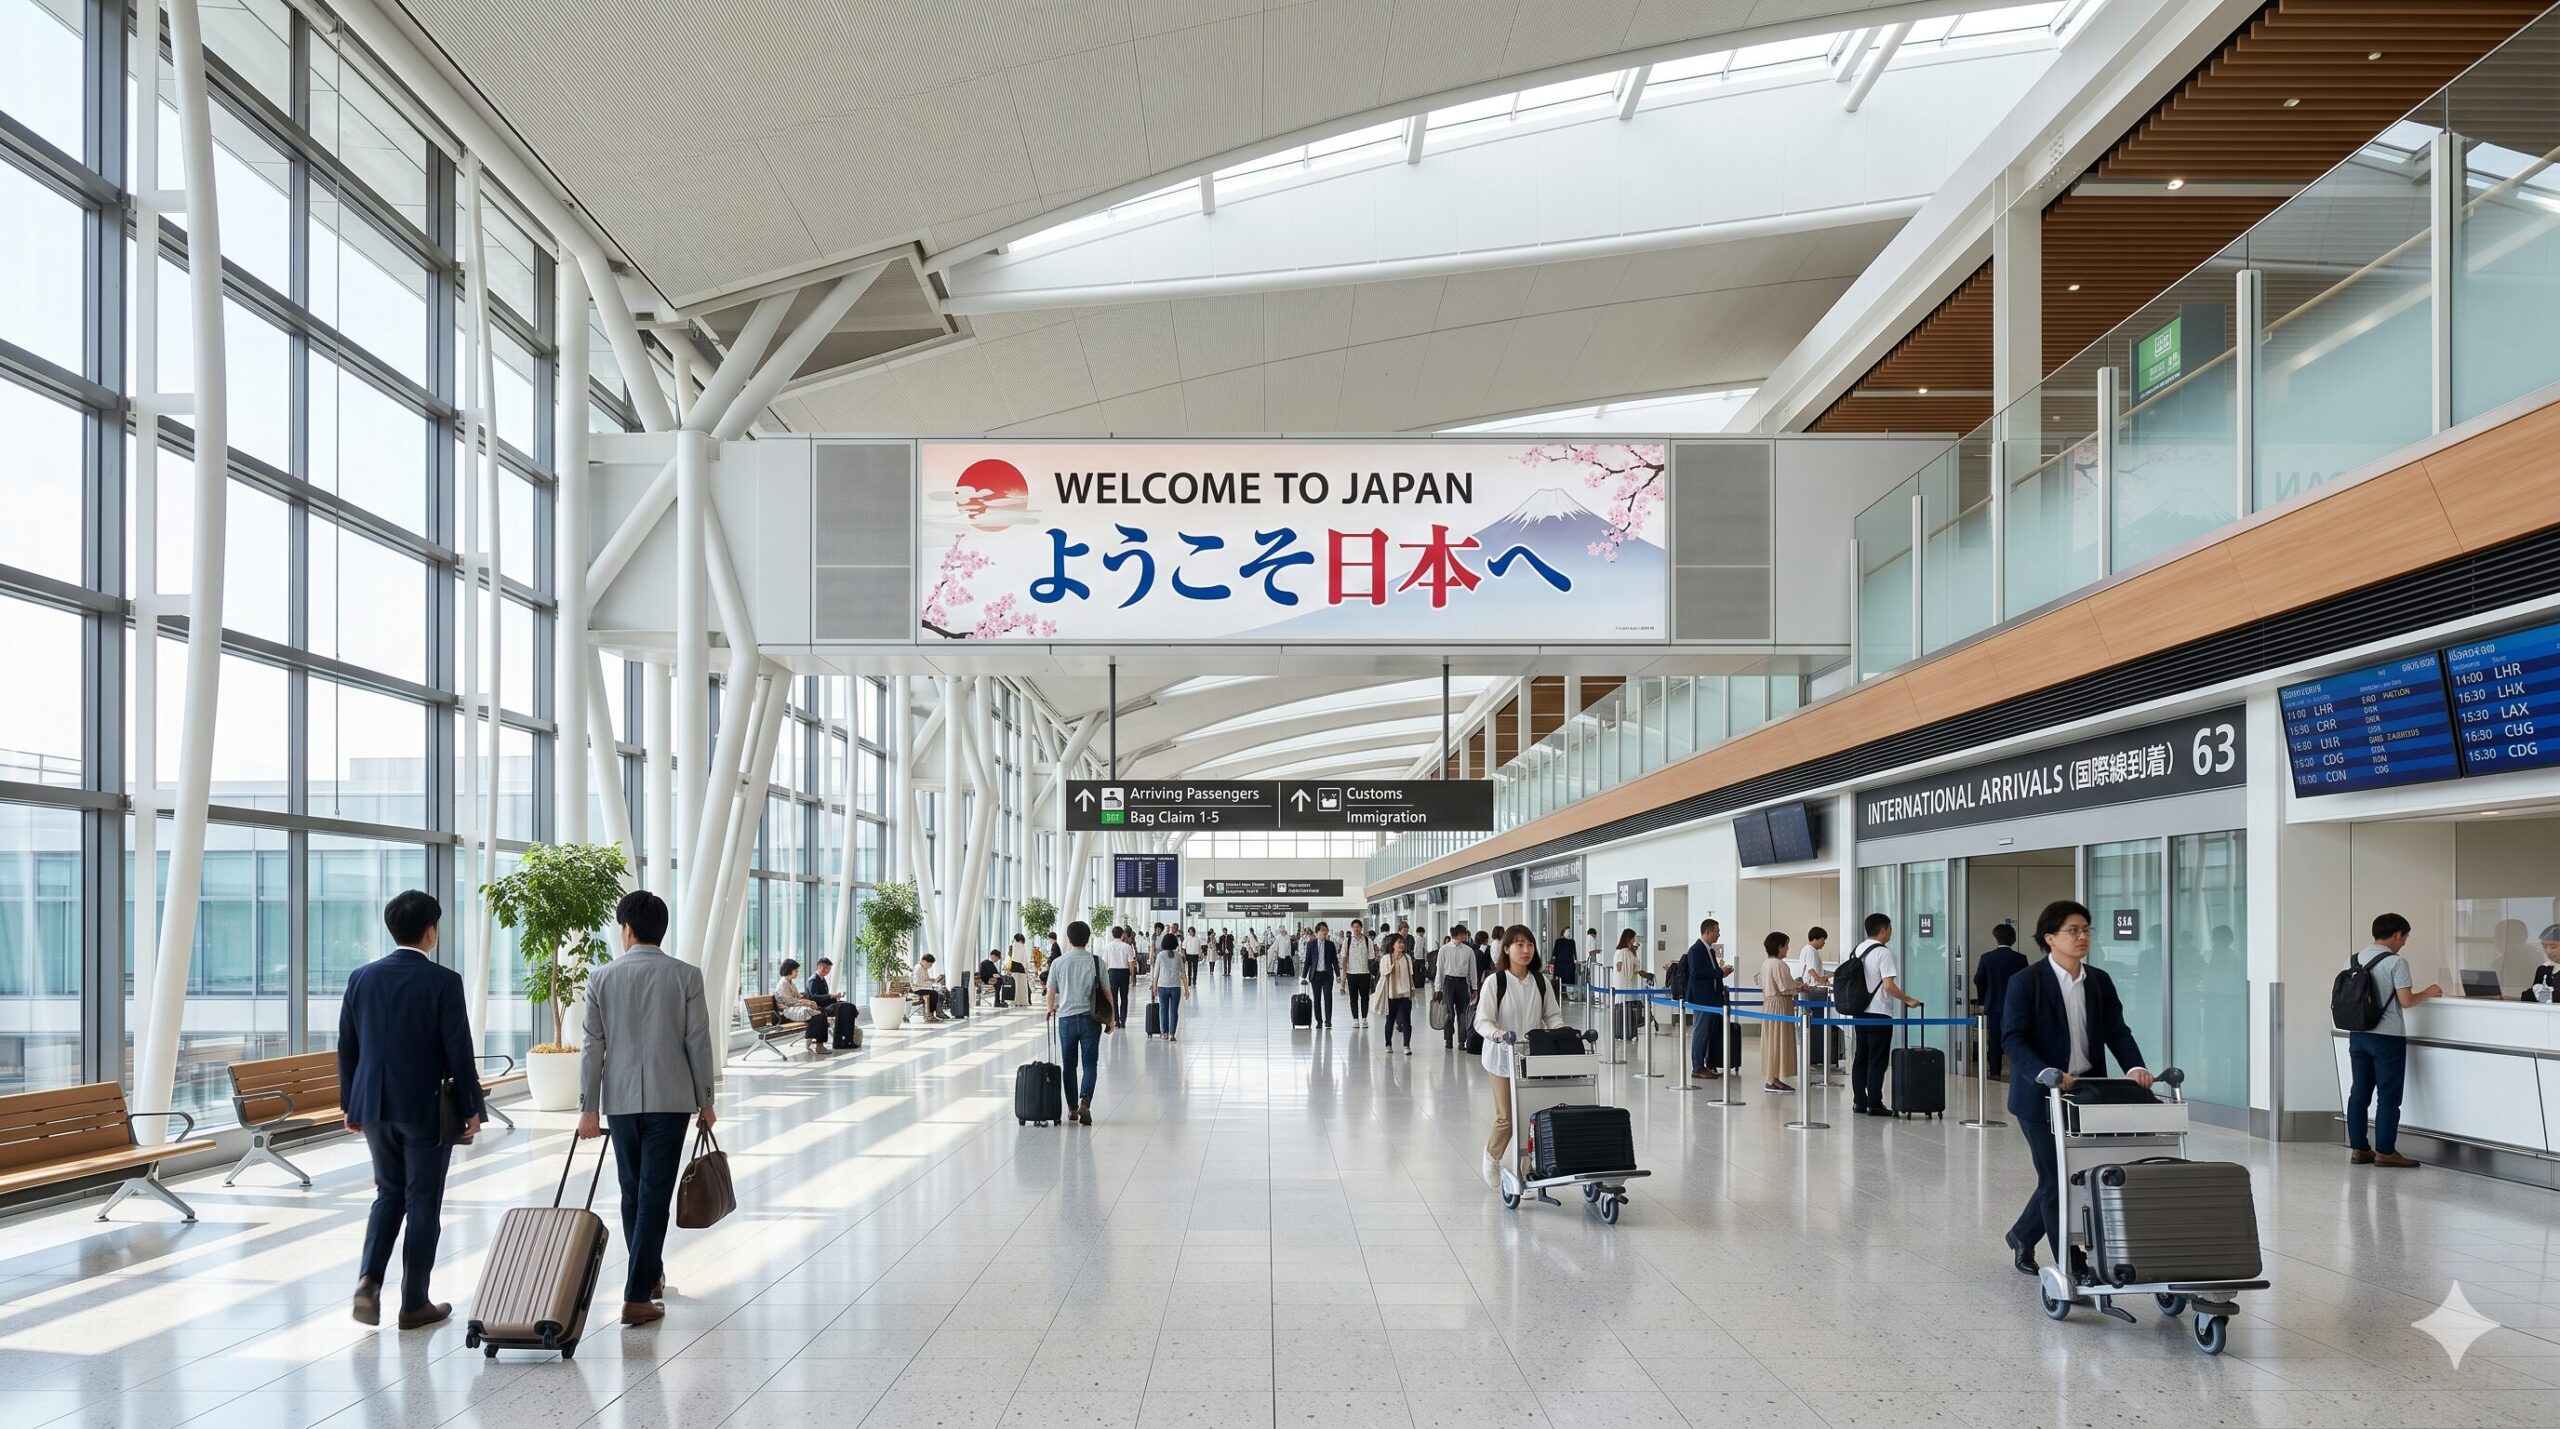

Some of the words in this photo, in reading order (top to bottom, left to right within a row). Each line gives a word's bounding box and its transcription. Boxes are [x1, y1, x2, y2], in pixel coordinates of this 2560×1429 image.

[1054, 472, 1261, 505] WELCOME
[1273, 472, 1329, 505] TO
[1341, 472, 1473, 505] JAPAN
[1029, 524, 1573, 608] ようこそ日本へ
[2494, 663, 2522, 680] LHR
[2313, 703, 2334, 716] LHR
[2461, 709, 2489, 724] 15:30
[2500, 702, 2530, 719] LAX
[2322, 752, 2345, 766] CDG
[2468, 748, 2497, 763] 15:30
[2508, 741, 2538, 758] CDG
[1867, 782, 1976, 826] INTERNATIONAL
[1979, 763, 2064, 807] ARRIVALS
[2069, 741, 2174, 791] (国際線到着)
[2192, 723, 2235, 776] 63
[2325, 769, 2347, 783] CON
[1130, 786, 1183, 803] Arriving
[1187, 786, 1260, 803] Passengers
[1346, 786, 1403, 801] Customs
[1130, 810, 1155, 828] Bag
[1158, 809, 1196, 824] Claim
[1199, 810, 1220, 824] 1-5
[1346, 809, 1427, 828] Immigration
